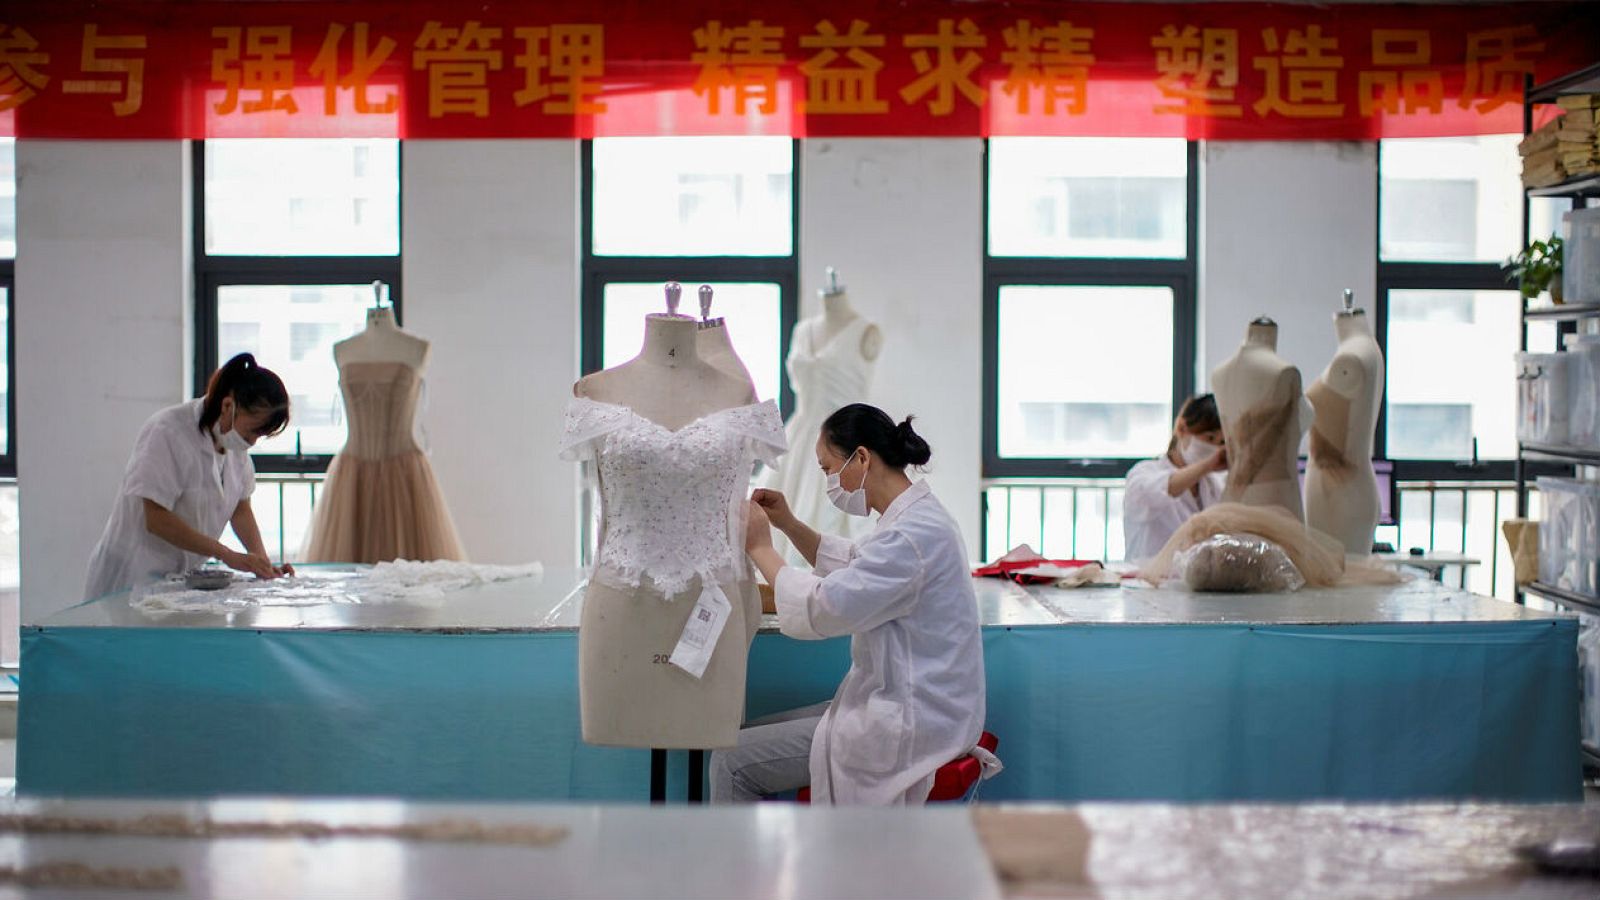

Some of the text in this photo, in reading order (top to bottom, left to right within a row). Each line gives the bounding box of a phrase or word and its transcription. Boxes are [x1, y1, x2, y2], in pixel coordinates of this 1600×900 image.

[211, 21, 608, 118] 强化管理
[692, 19, 1096, 116] 精益求精
[1150, 24, 1546, 118] 塑造品质
[668, 348, 675, 357] 4
